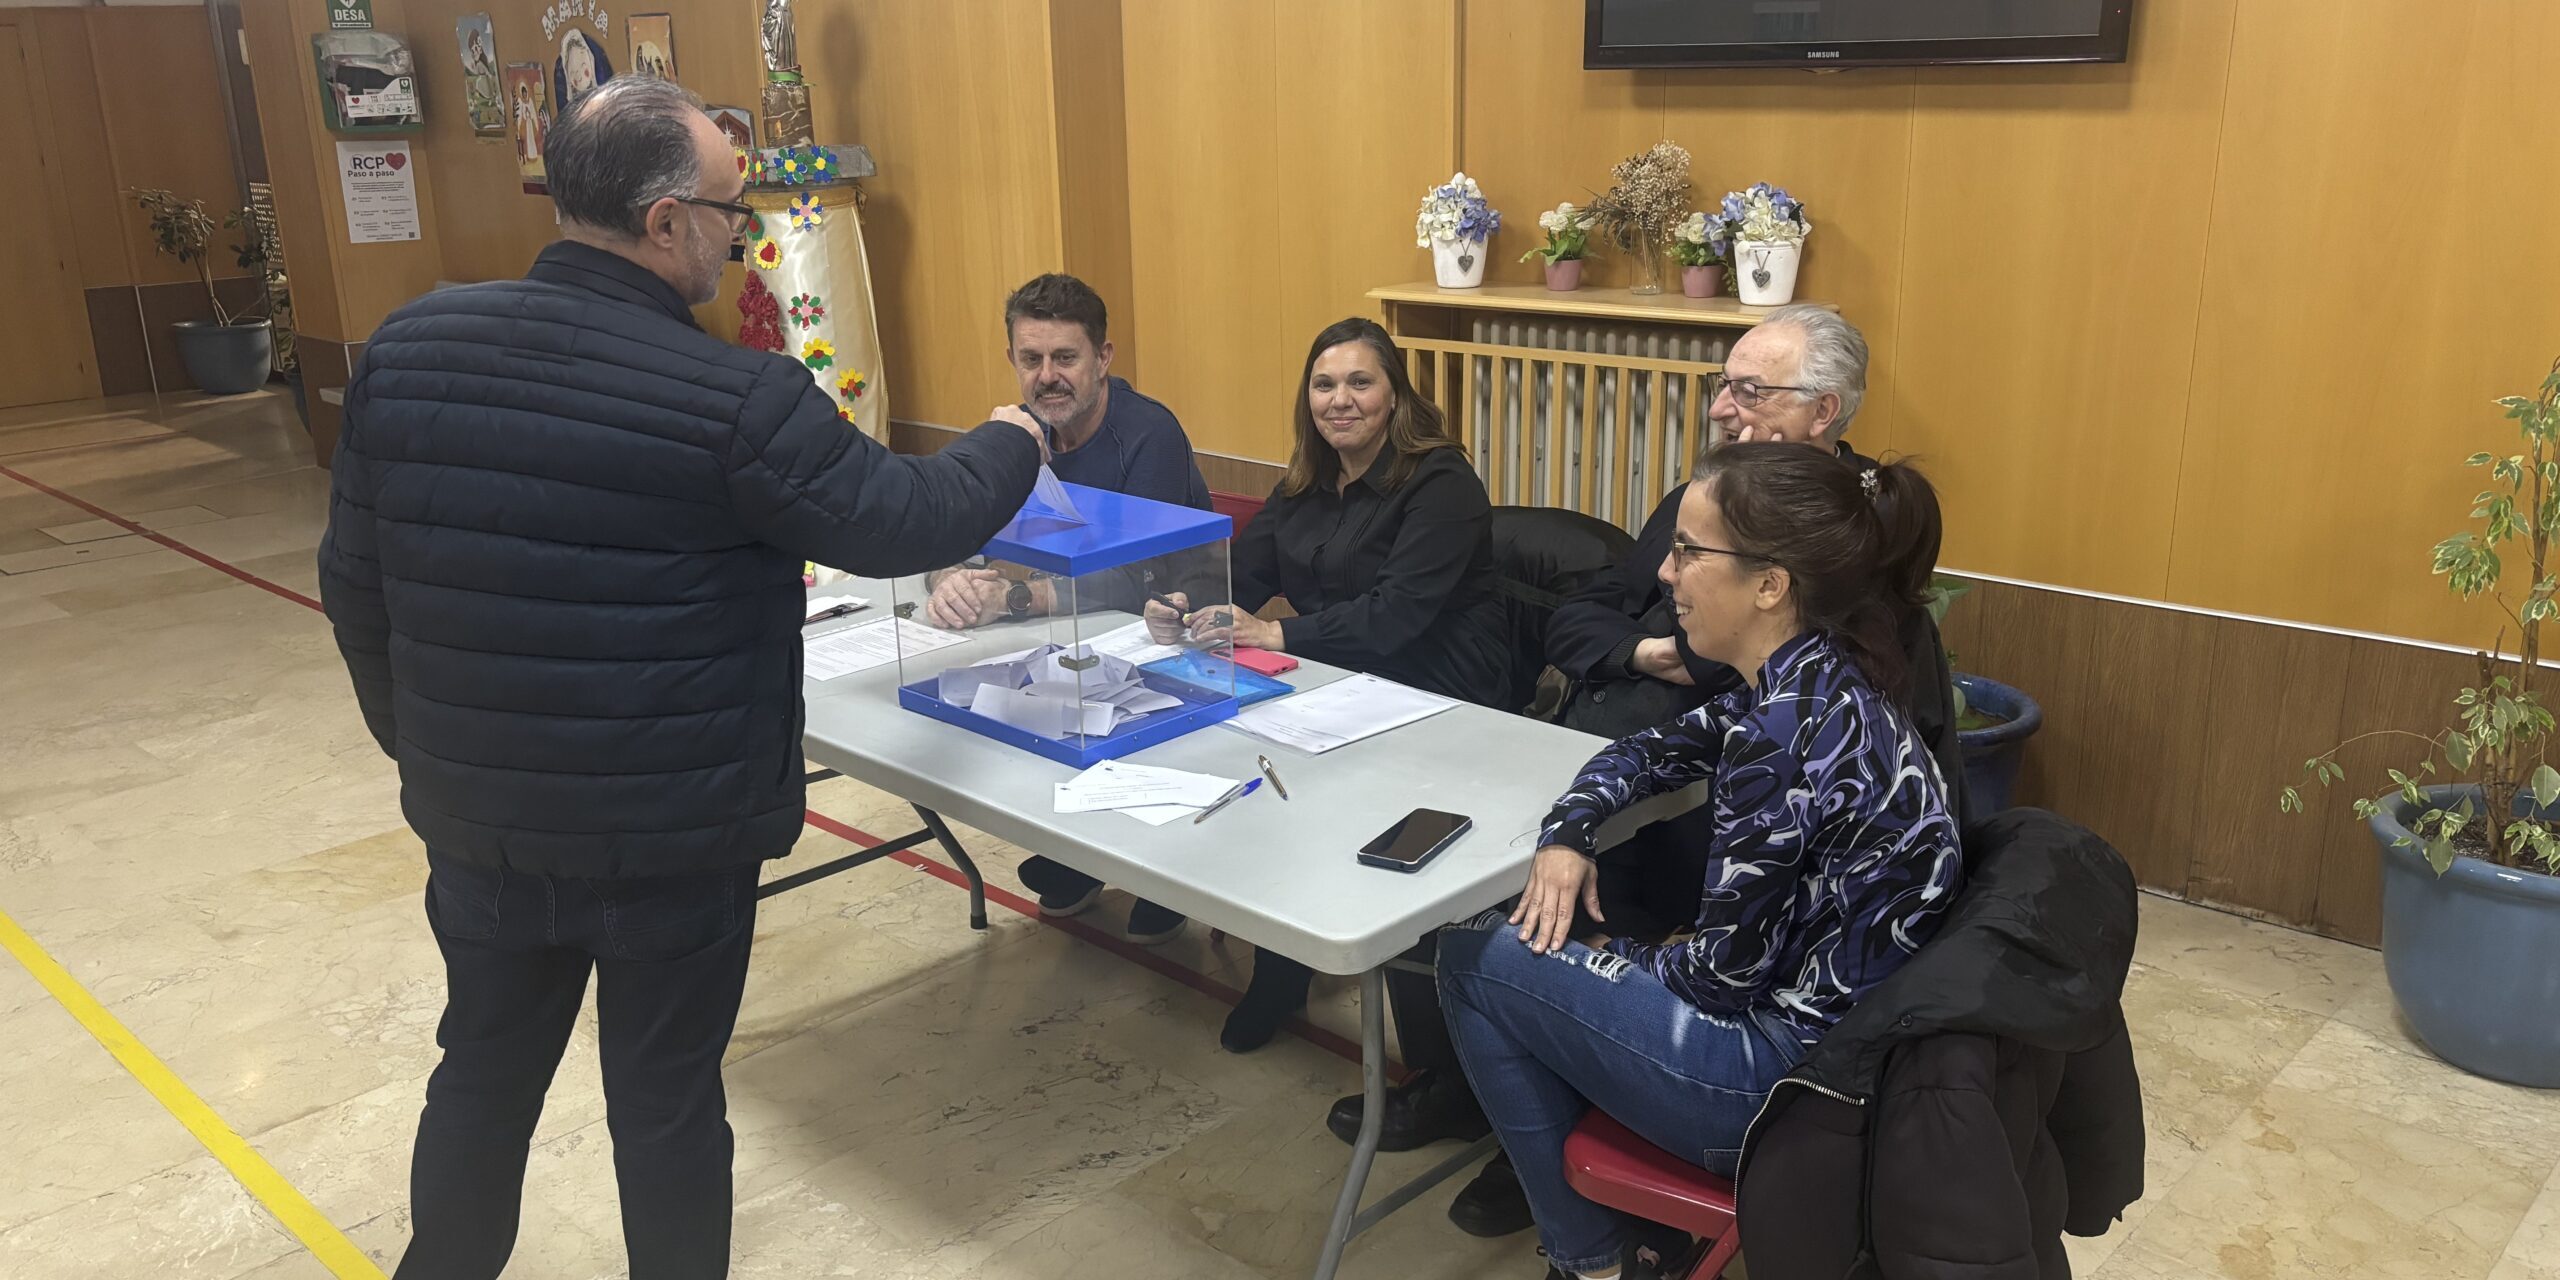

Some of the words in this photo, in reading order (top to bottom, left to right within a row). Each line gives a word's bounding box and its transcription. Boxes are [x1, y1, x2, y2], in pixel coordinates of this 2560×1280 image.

[334, 9, 366, 21] DESA
[1807, 50, 1840, 59] SAMSUNG
[352, 157, 385, 170] RCP
[376, 170, 395, 178] paso
